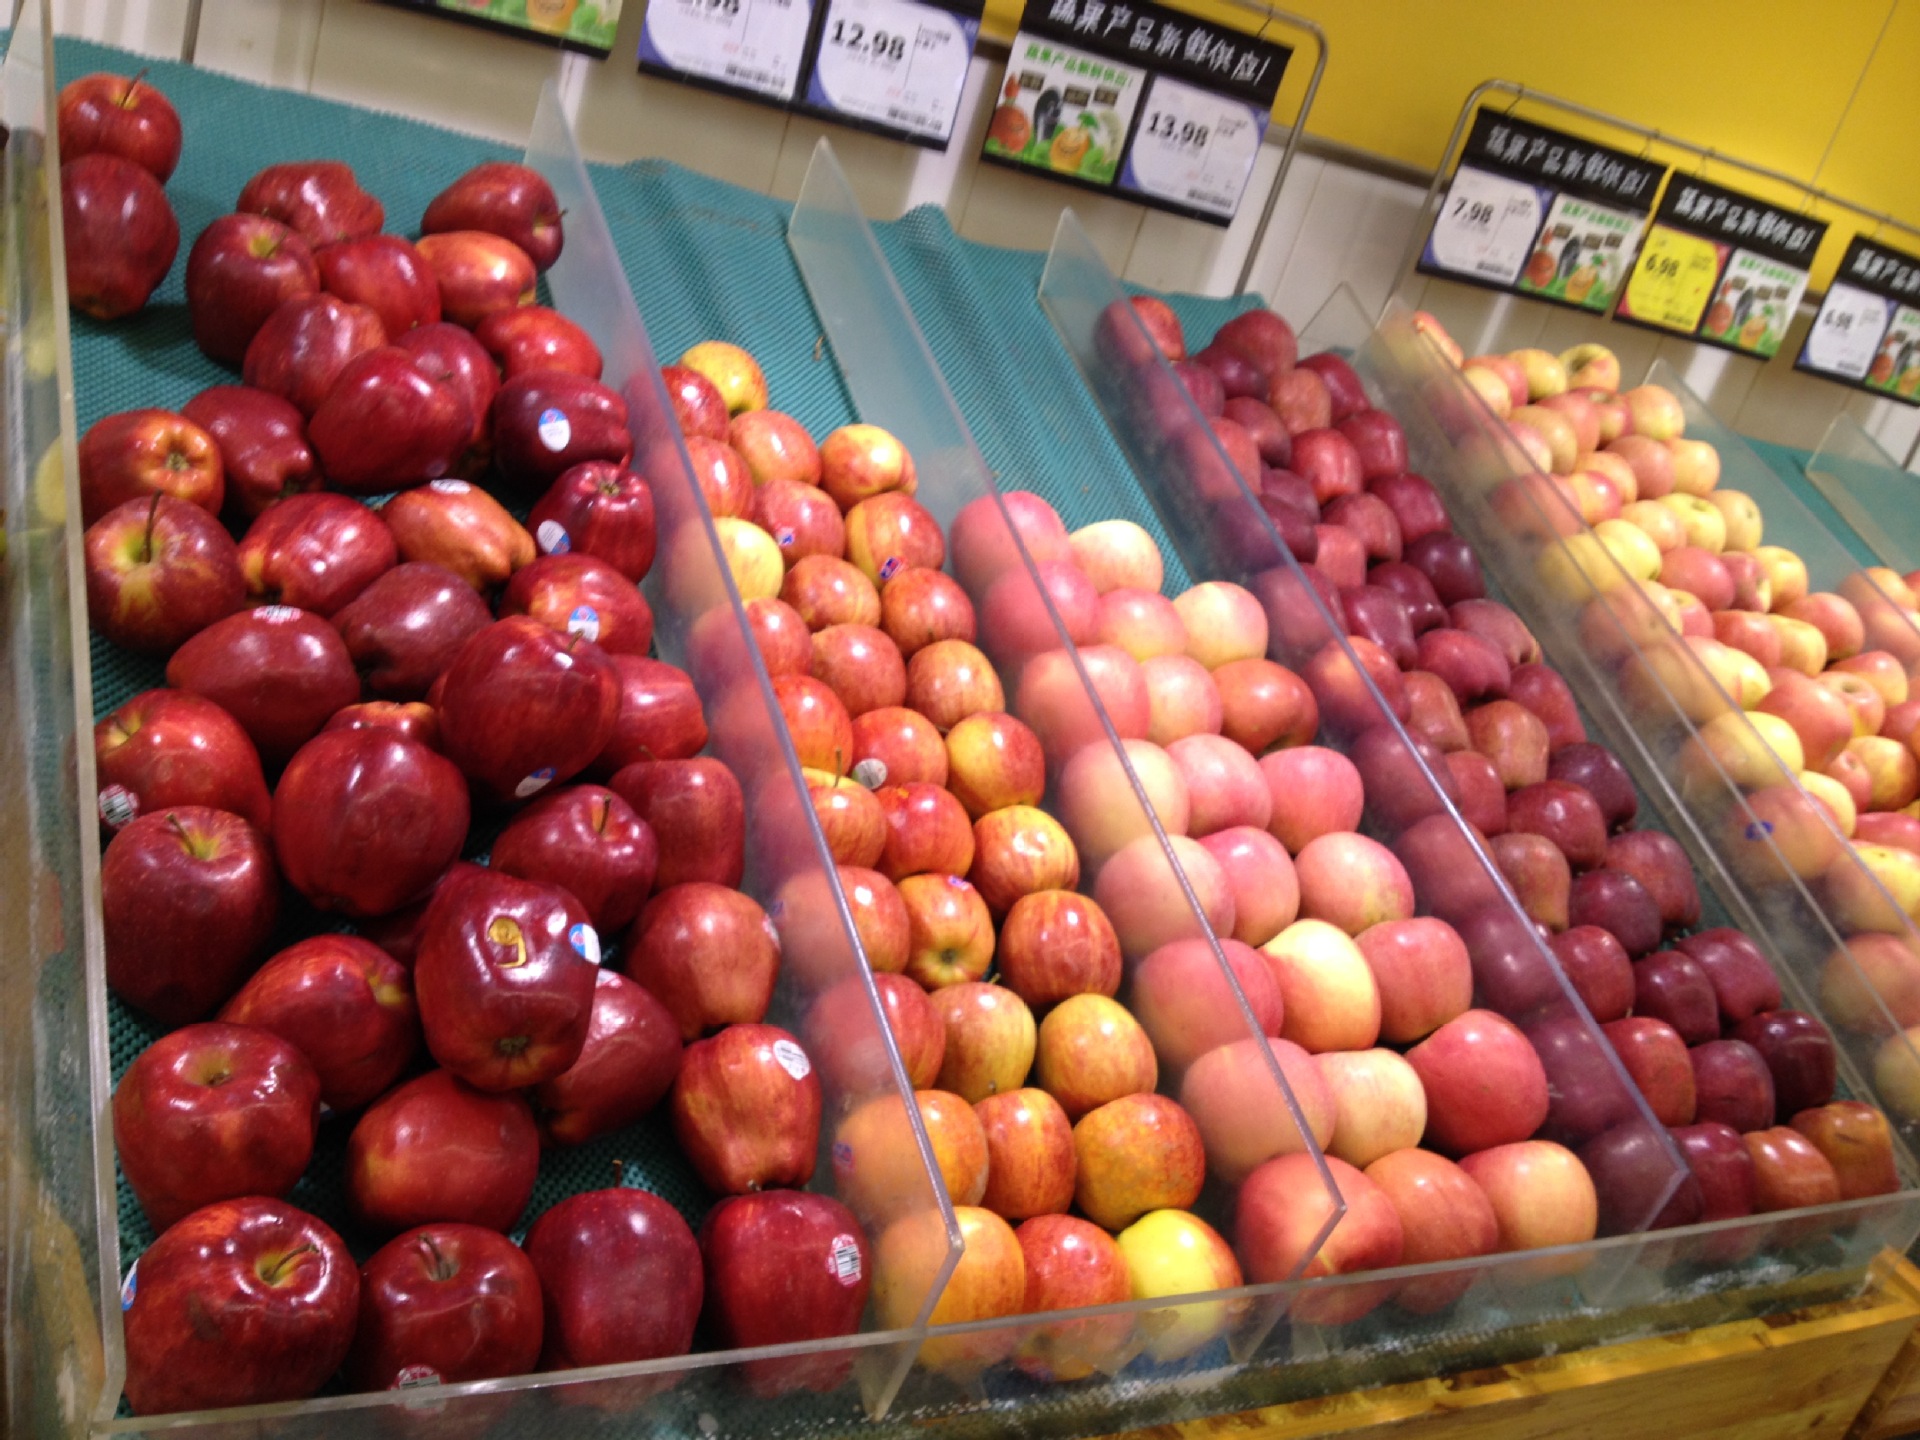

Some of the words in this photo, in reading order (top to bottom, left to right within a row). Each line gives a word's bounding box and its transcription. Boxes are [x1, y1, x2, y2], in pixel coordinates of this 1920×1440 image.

[831, 18, 906, 61] 12.98
[1146, 110, 1209, 148] 13.98
[1451, 196, 1494, 224] 7.98
[1645, 253, 1680, 277] 6.98
